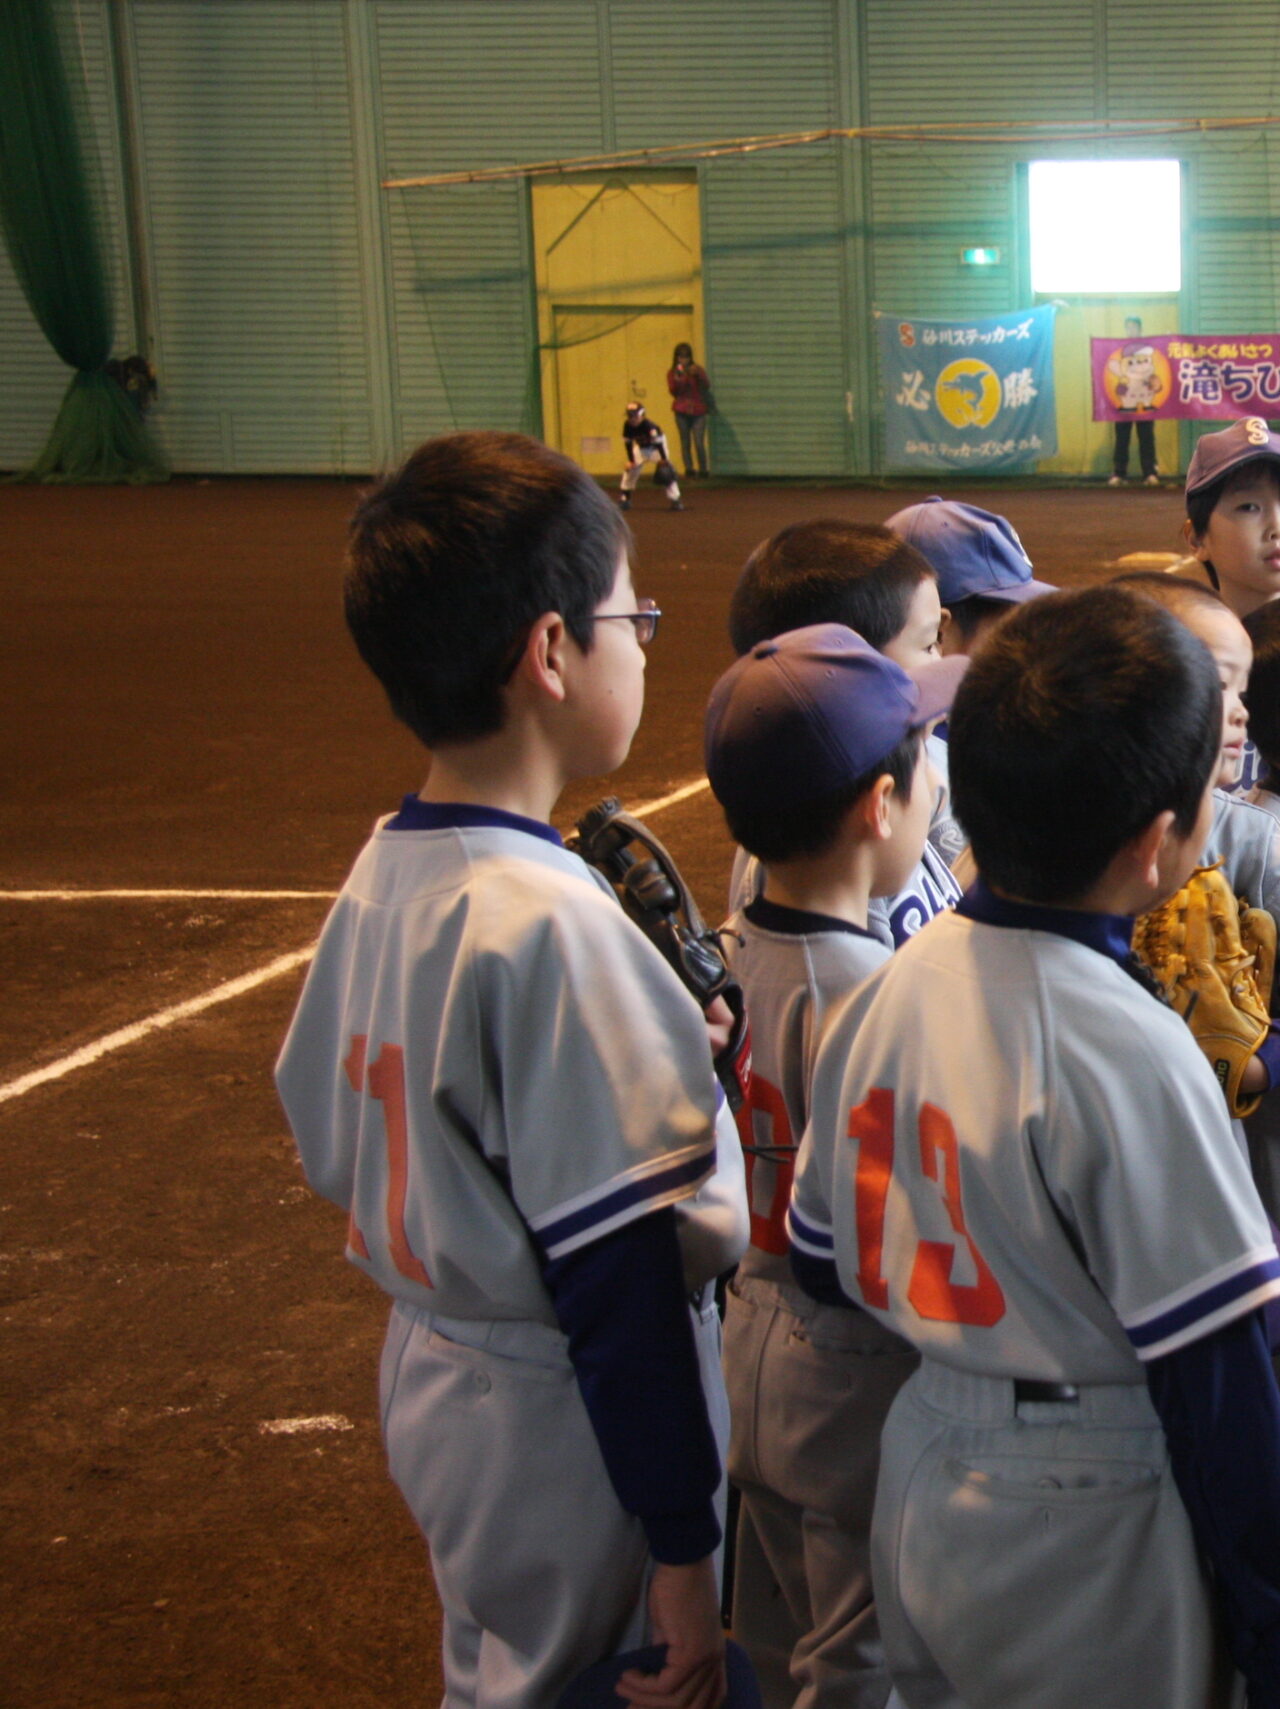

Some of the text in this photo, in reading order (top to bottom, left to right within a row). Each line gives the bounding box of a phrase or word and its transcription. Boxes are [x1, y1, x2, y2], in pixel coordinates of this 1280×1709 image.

[900, 323, 915, 346] S
[1245, 416, 1270, 446] S
[848, 1088, 1006, 1327] 13
